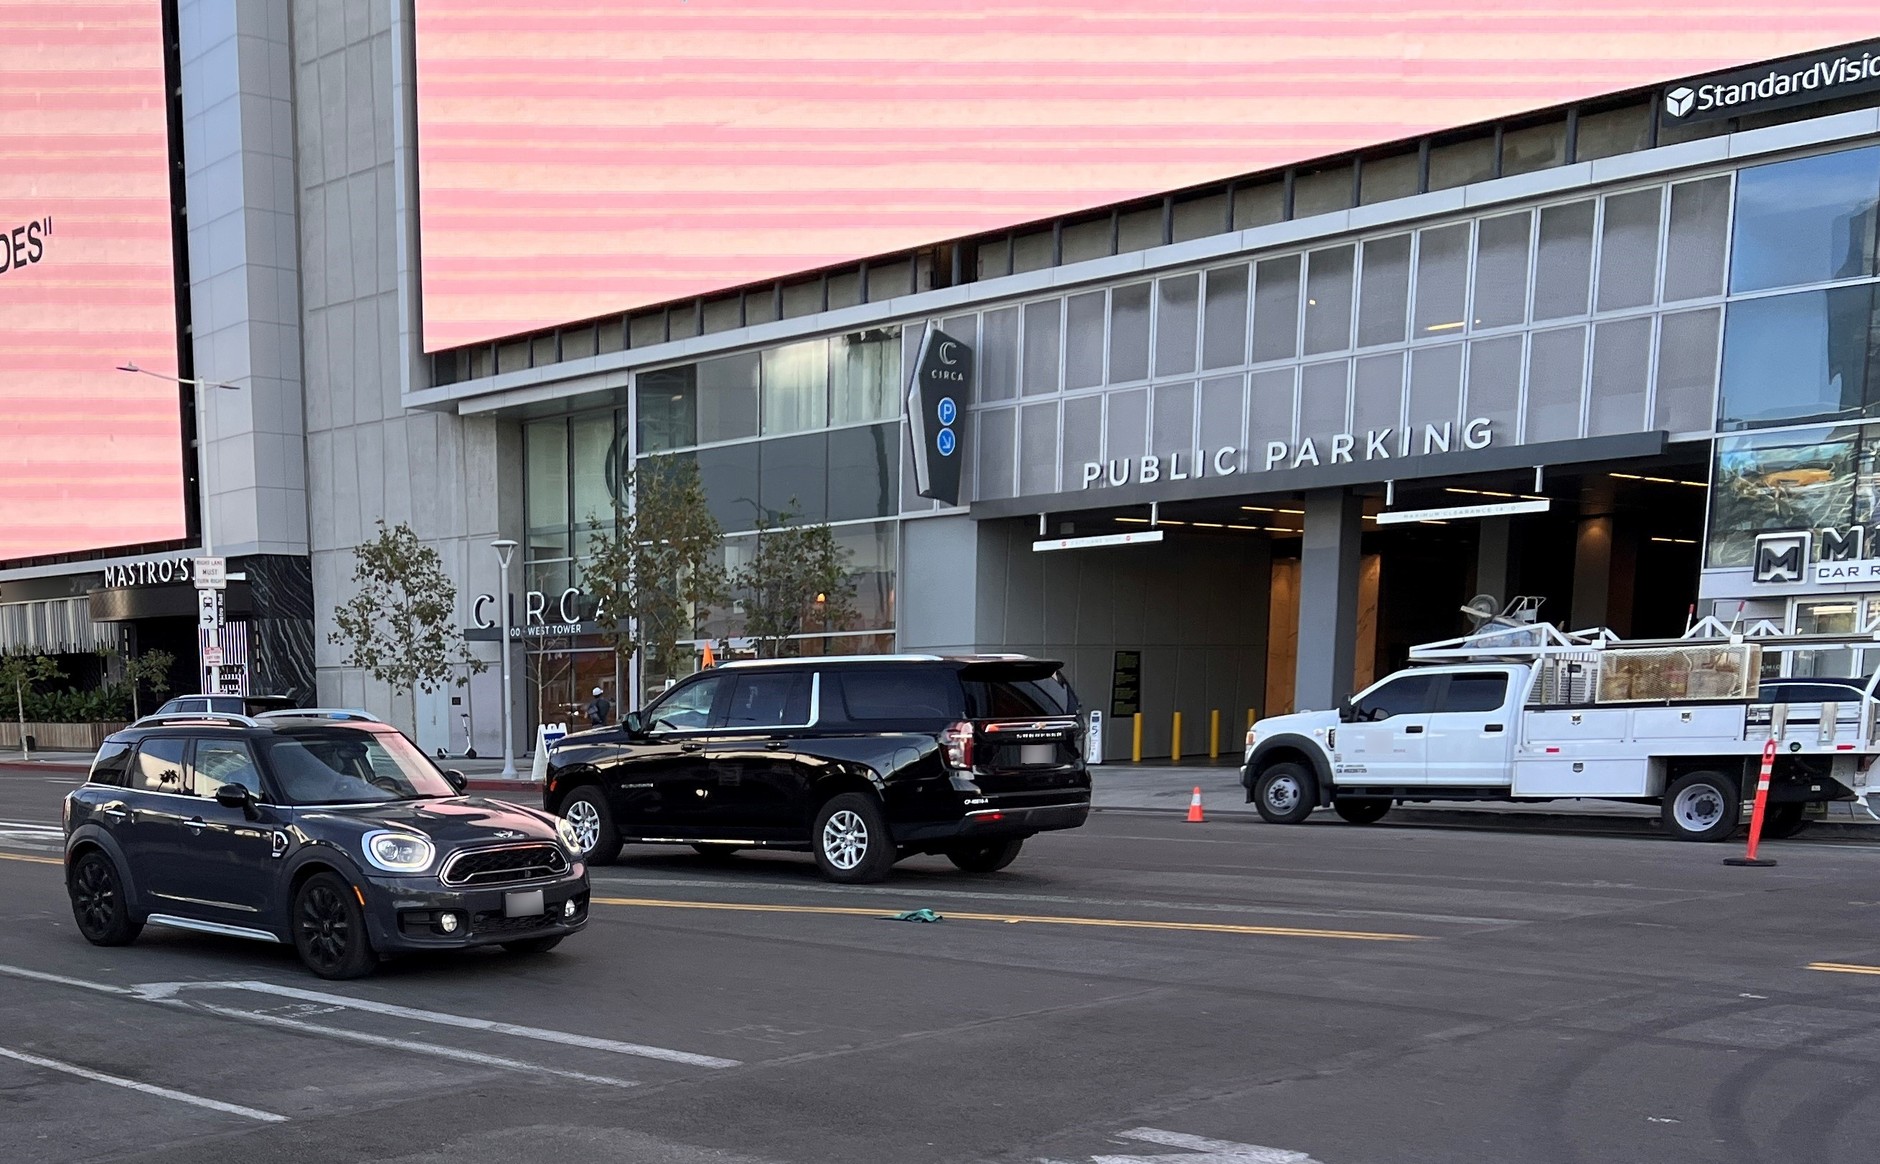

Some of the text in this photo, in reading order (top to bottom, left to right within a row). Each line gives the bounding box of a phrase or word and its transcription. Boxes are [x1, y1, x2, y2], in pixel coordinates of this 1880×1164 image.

[931, 369, 964, 381] CIRCA
[1082, 418, 1493, 490] PUBLIC PARKING
[1443, 507, 1492, 516] CLEARANCE
[104, 557, 189, 589] MASTRO'S
[1818, 566, 1859, 578] CAR
[527, 625, 550, 636] WEST
[552, 624, 582, 634] TOWER
